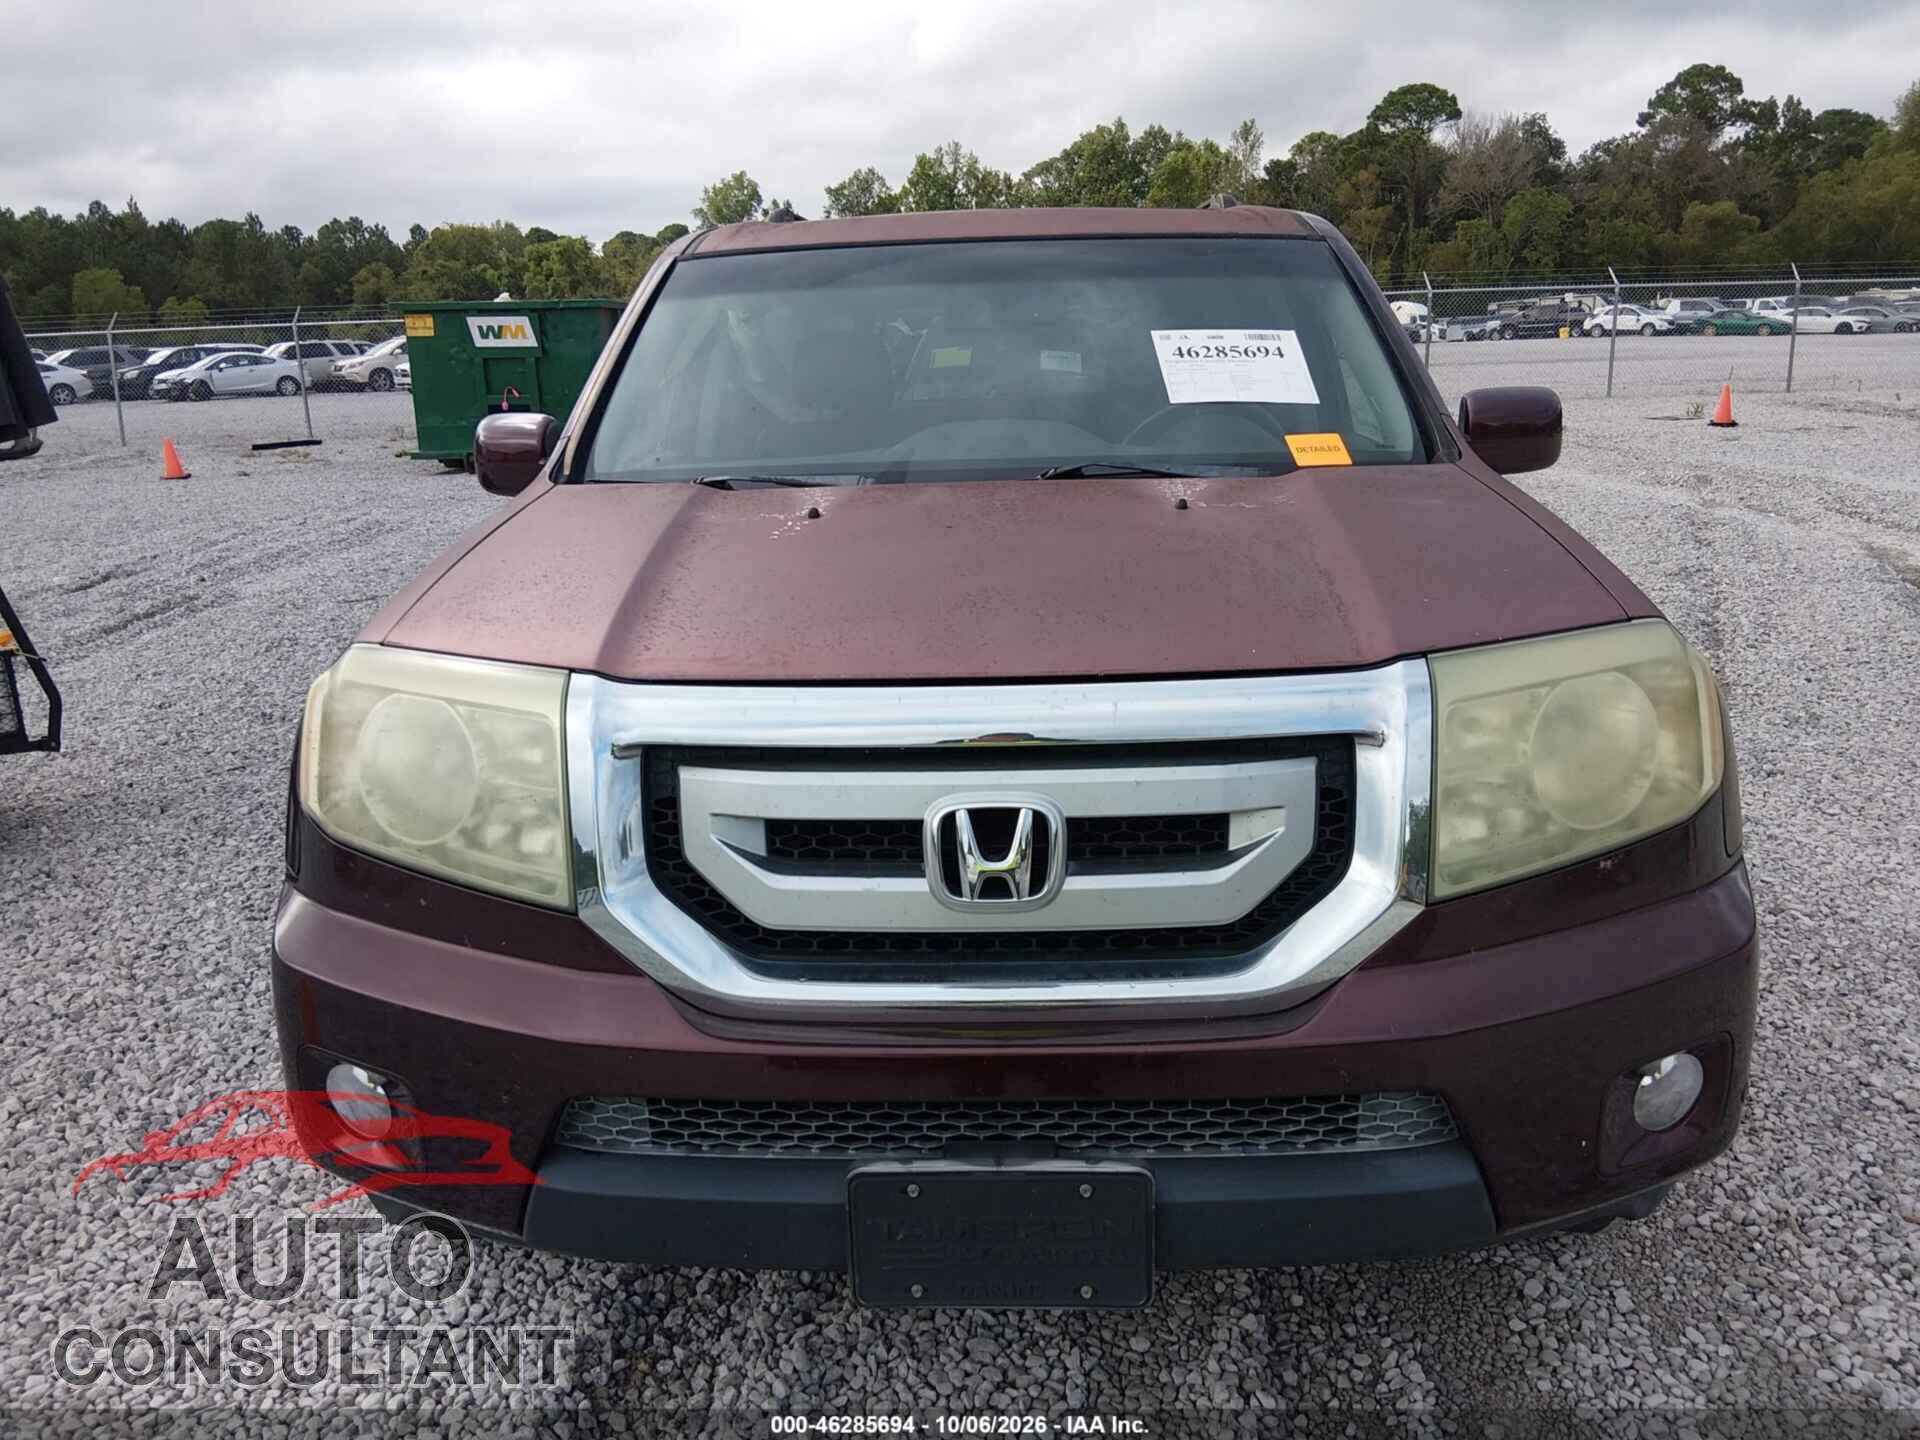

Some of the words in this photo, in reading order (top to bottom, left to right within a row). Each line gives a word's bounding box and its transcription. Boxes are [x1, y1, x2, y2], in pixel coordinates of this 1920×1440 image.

[477, 324, 529, 340] WM
[1171, 345, 1285, 359] 46285694
[1295, 445, 1341, 454] DETAILED
